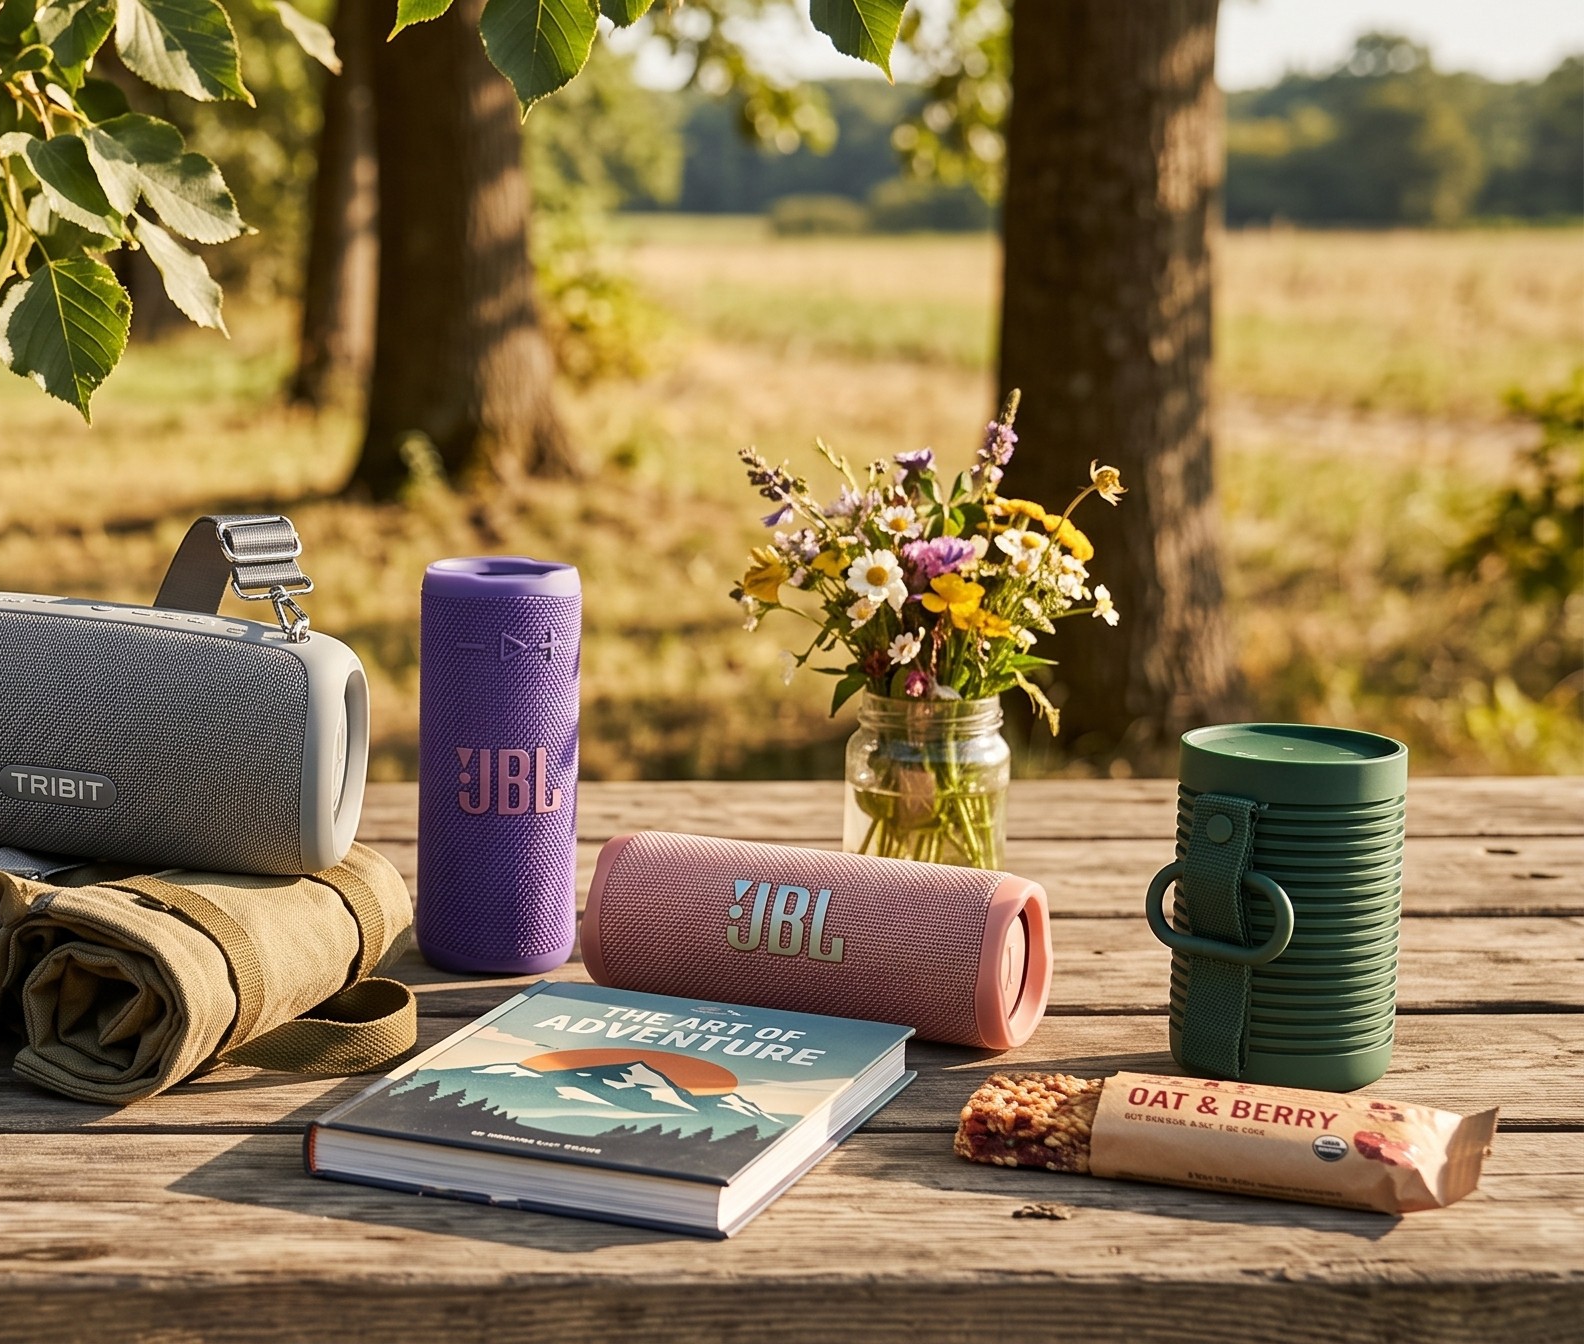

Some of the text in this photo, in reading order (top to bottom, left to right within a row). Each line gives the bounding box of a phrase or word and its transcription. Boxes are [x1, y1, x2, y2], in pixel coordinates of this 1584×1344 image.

[11, 772, 103, 801] TRIBIT
[456, 747, 562, 815] JBL
[726, 879, 845, 963] JBL
[533, 1014, 827, 1067] ADVENTURE
[603, 1006, 807, 1043] THE ART OF
[1127, 1086, 1190, 1111] OAT
[1196, 1095, 1220, 1117] &
[1230, 1099, 1339, 1131] BERRY
